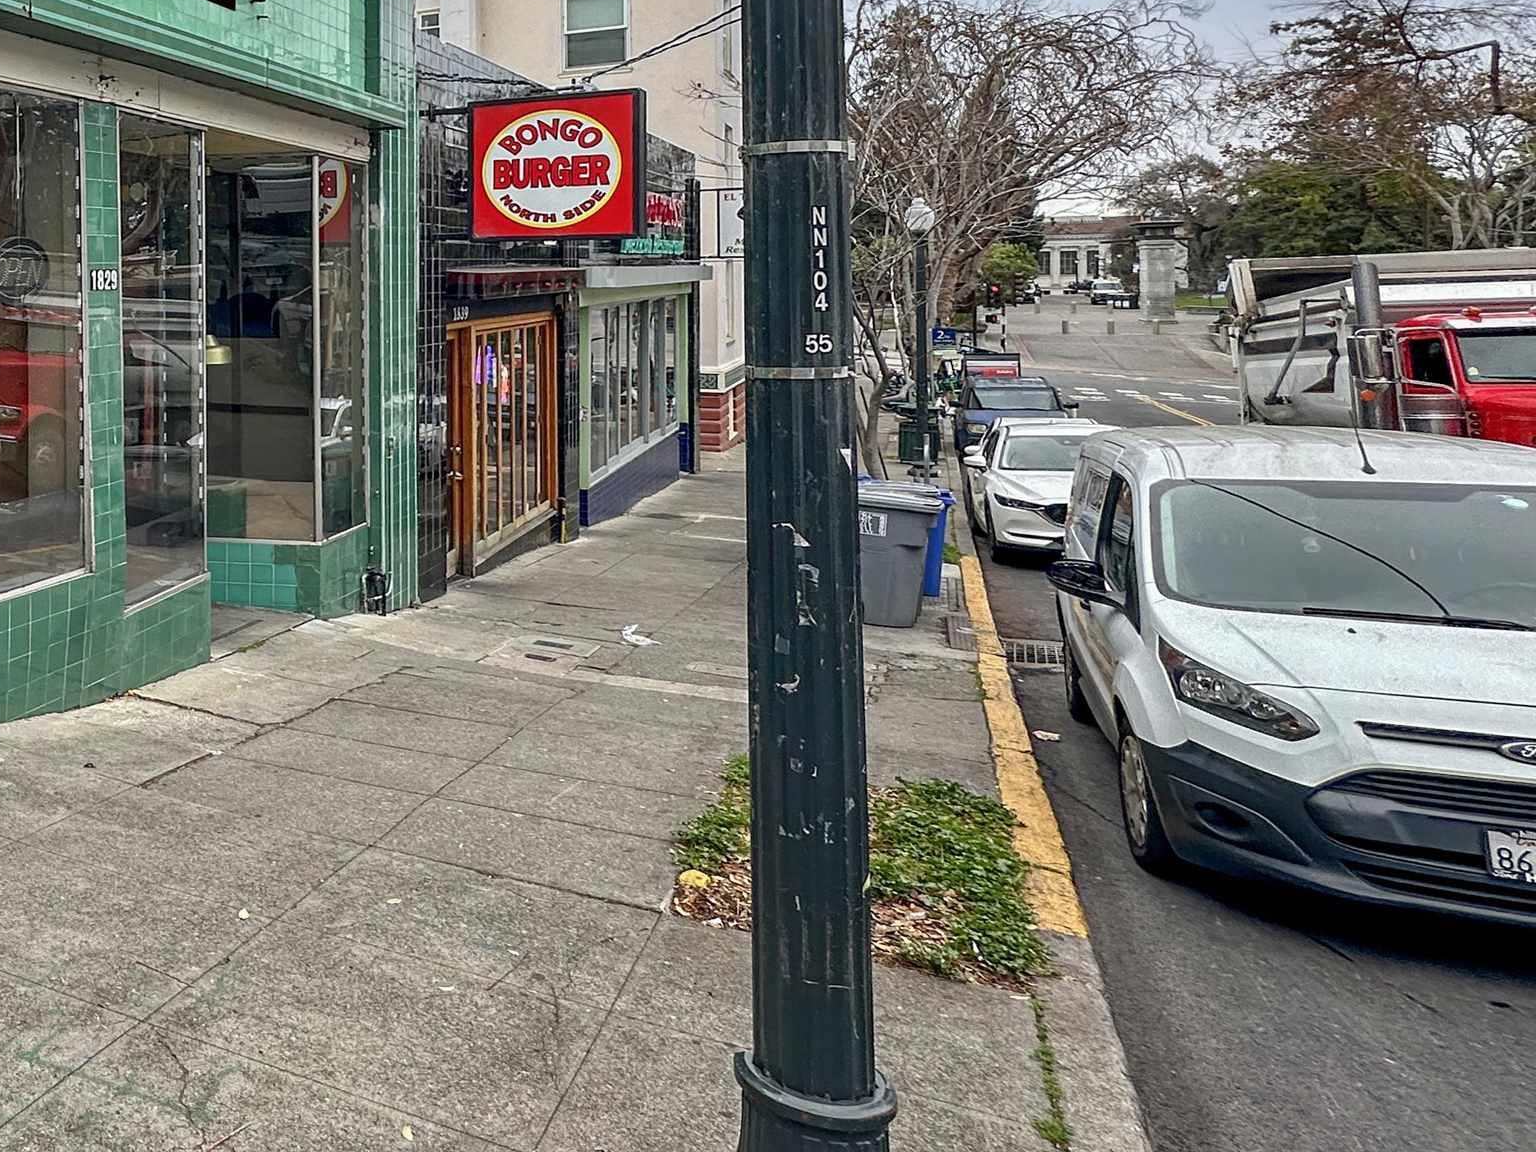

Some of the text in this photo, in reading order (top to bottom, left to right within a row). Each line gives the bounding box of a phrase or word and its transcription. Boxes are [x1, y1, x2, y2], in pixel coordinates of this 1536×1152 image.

[498, 118, 603, 156] BONGO
[492, 154, 611, 190] BURGER
[499, 189, 607, 223] NORTH SIDE
[724, 193, 736, 201] EL
[90, 269, 118, 290] 1829
[804, 334, 833, 354] 55
